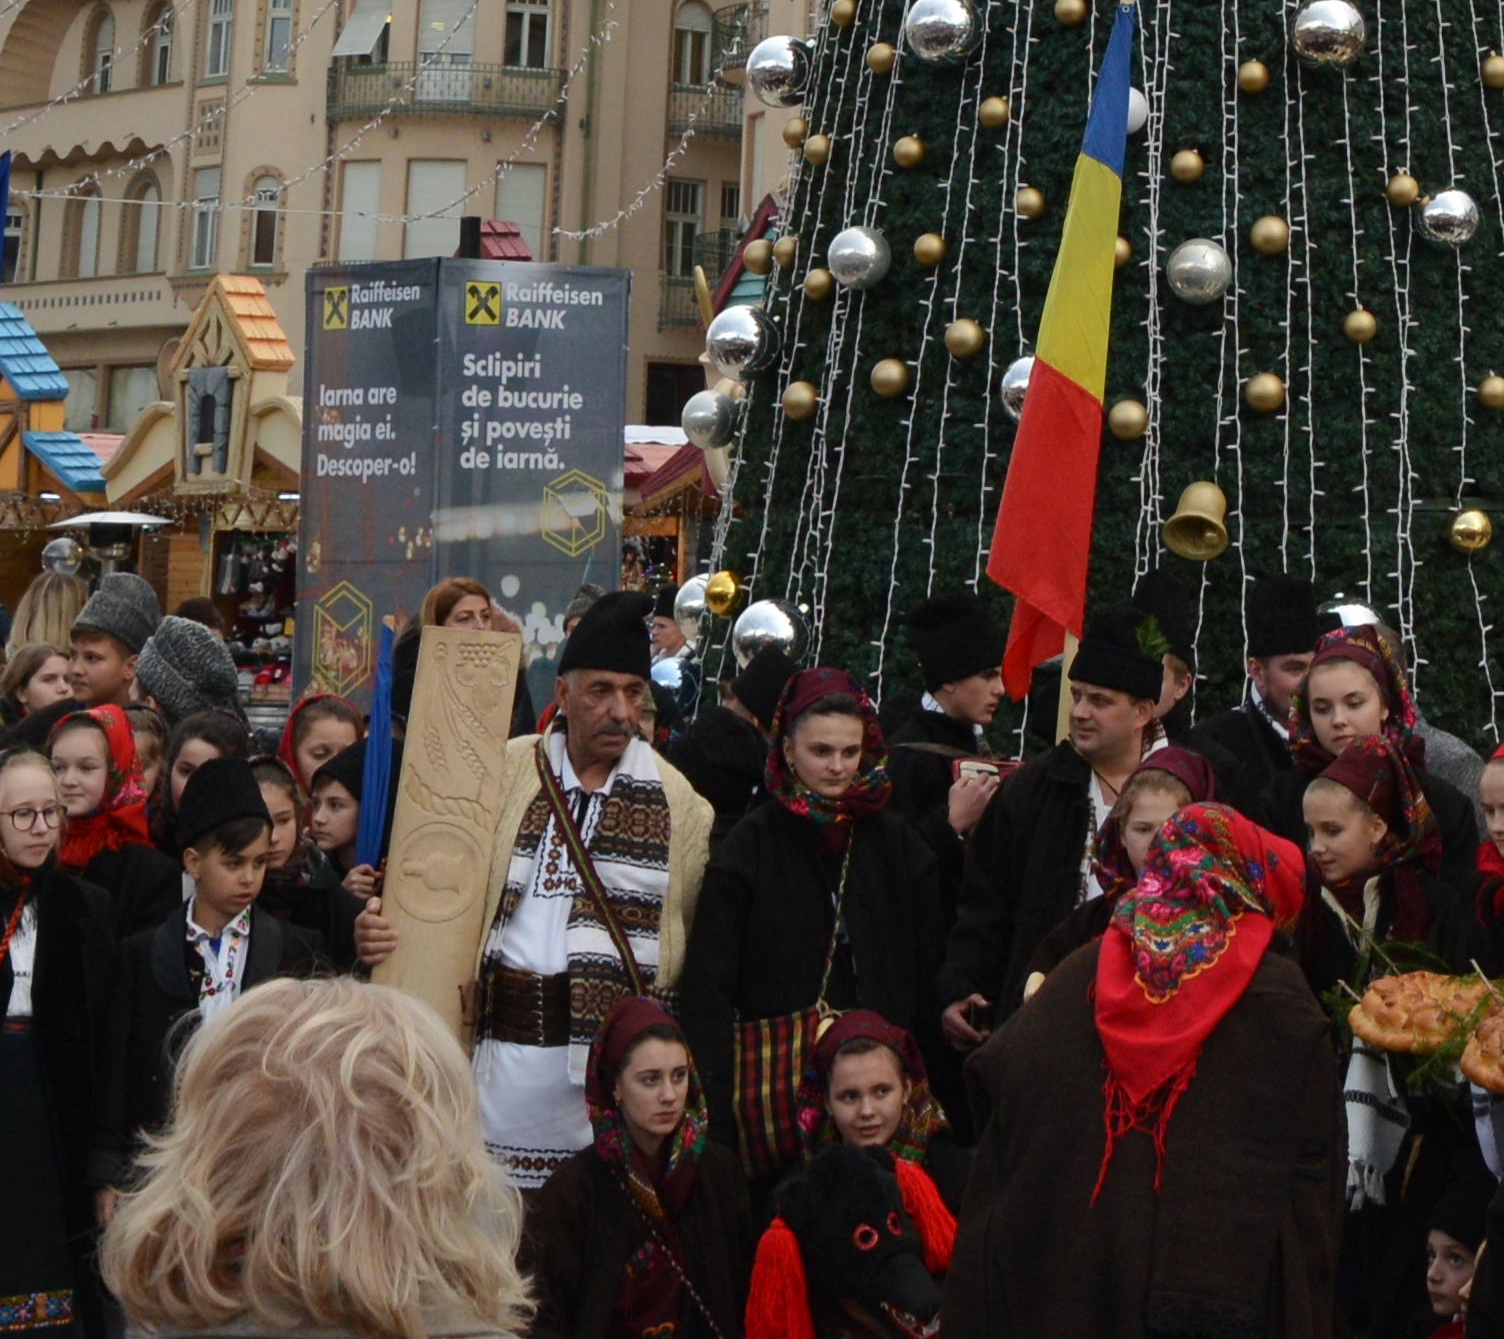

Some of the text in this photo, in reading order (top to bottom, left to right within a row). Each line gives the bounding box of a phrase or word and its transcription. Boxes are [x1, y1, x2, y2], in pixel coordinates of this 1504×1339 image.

[351, 280, 421, 304] Raiffeisen
[505, 281, 603, 305] Raiffeisen
[350, 307, 395, 330] BANK
[505, 307, 567, 330] BANK
[462, 351, 542, 385] Sclipiri
[319, 384, 397, 407] Iarna are
[461, 384, 583, 410] de bucurie
[318, 413, 396, 449] magia ei.
[461, 412, 571, 447] și povești
[317, 451, 416, 484] Descoper-o!
[460, 443, 565, 470] de iarnă.
